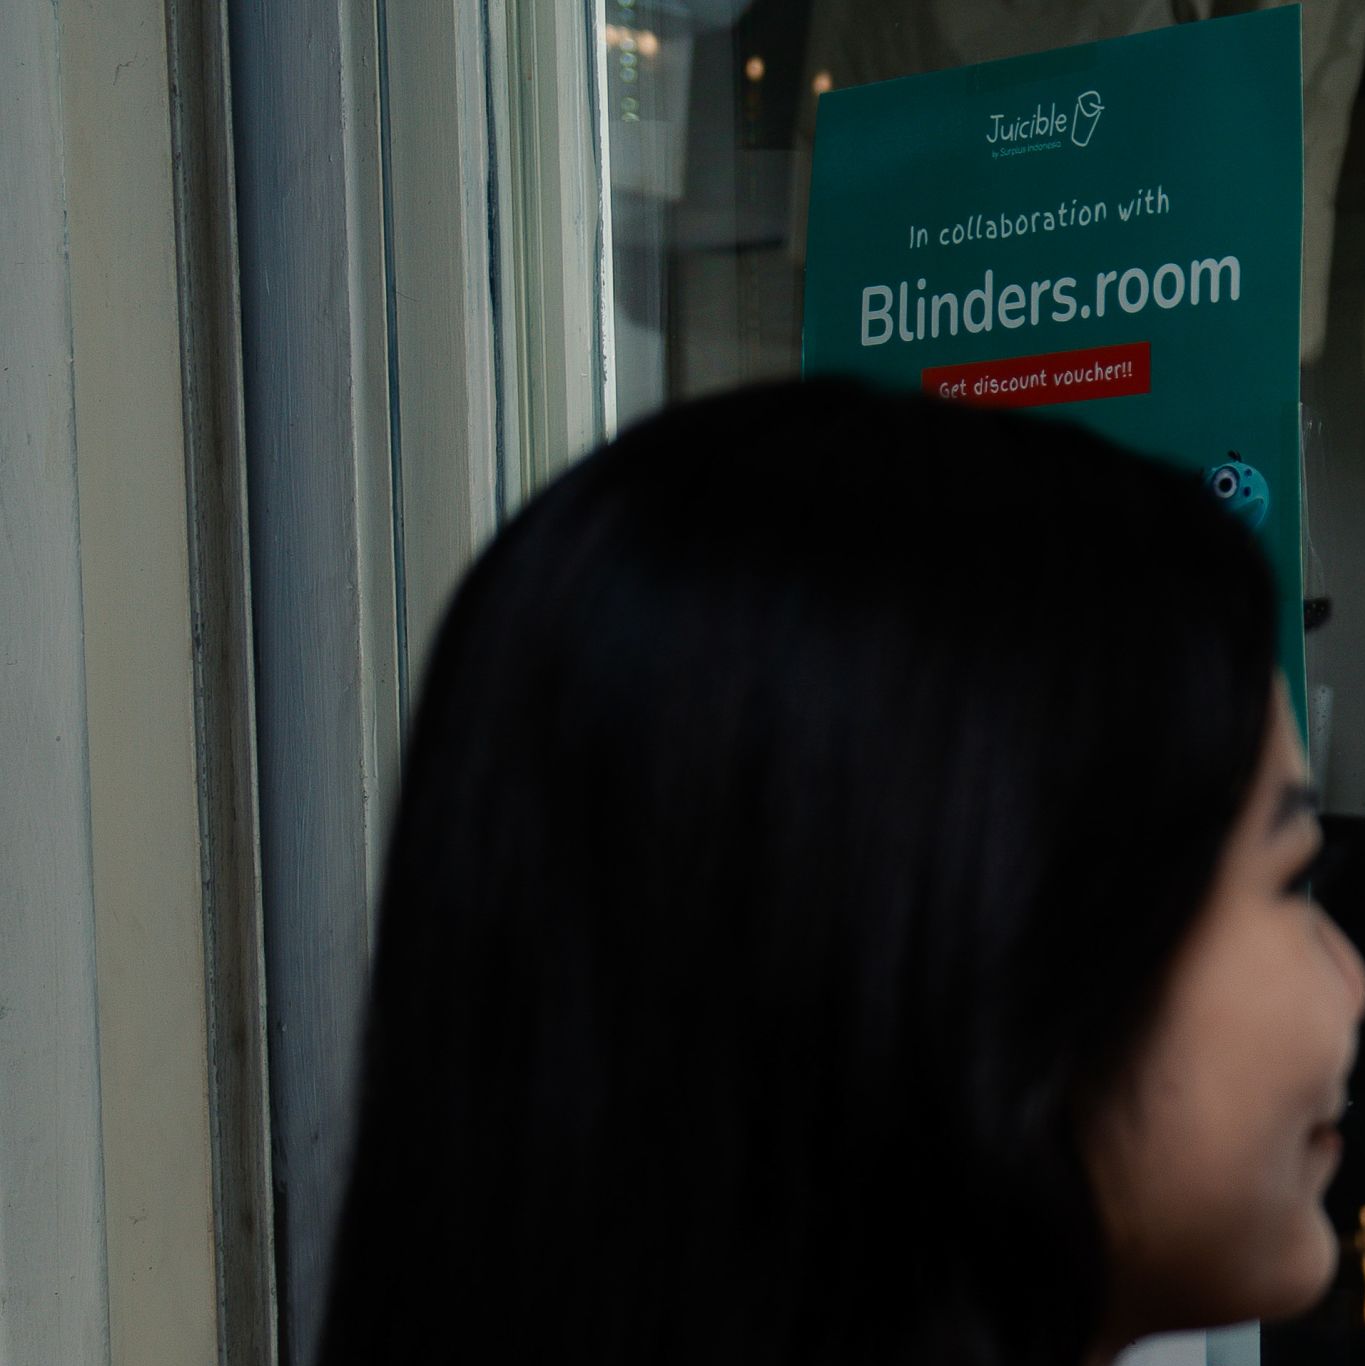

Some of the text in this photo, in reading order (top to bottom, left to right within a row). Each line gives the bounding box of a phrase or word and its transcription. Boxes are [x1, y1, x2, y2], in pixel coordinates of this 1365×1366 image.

[986, 102, 1067, 143] Juicible
[1000, 146, 1026, 157] Surplus
[909, 184, 1169, 249] In collaboration with
[861, 255, 1241, 347] Blinders.room
[939, 360, 1133, 400] Get discount voucher!!
